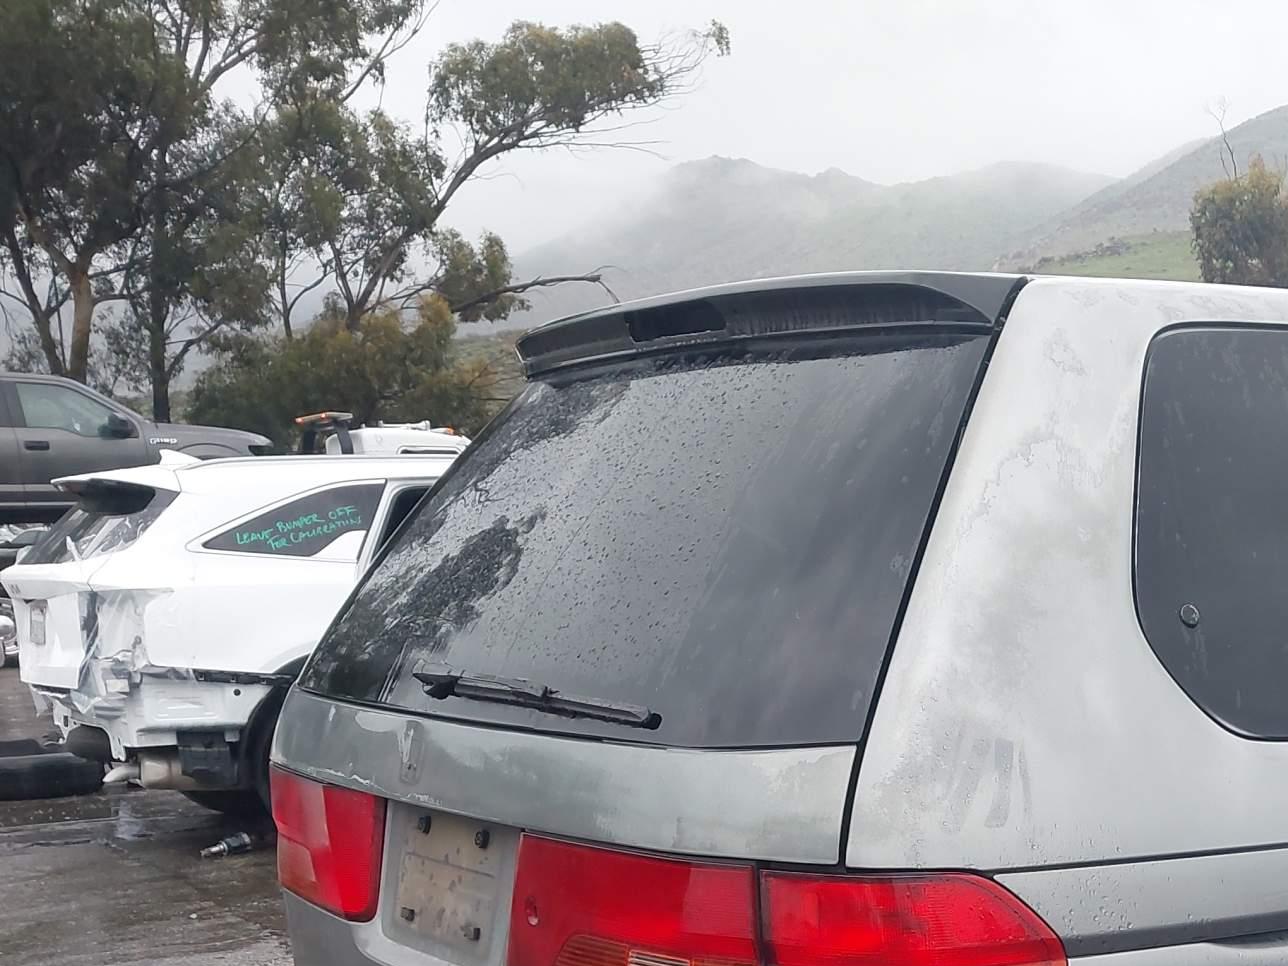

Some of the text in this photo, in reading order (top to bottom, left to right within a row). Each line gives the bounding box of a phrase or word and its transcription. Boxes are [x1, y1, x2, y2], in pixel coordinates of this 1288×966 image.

[236, 505, 358, 545] LEAVE BUMPER OFF
[267, 534, 293, 551] FOR
